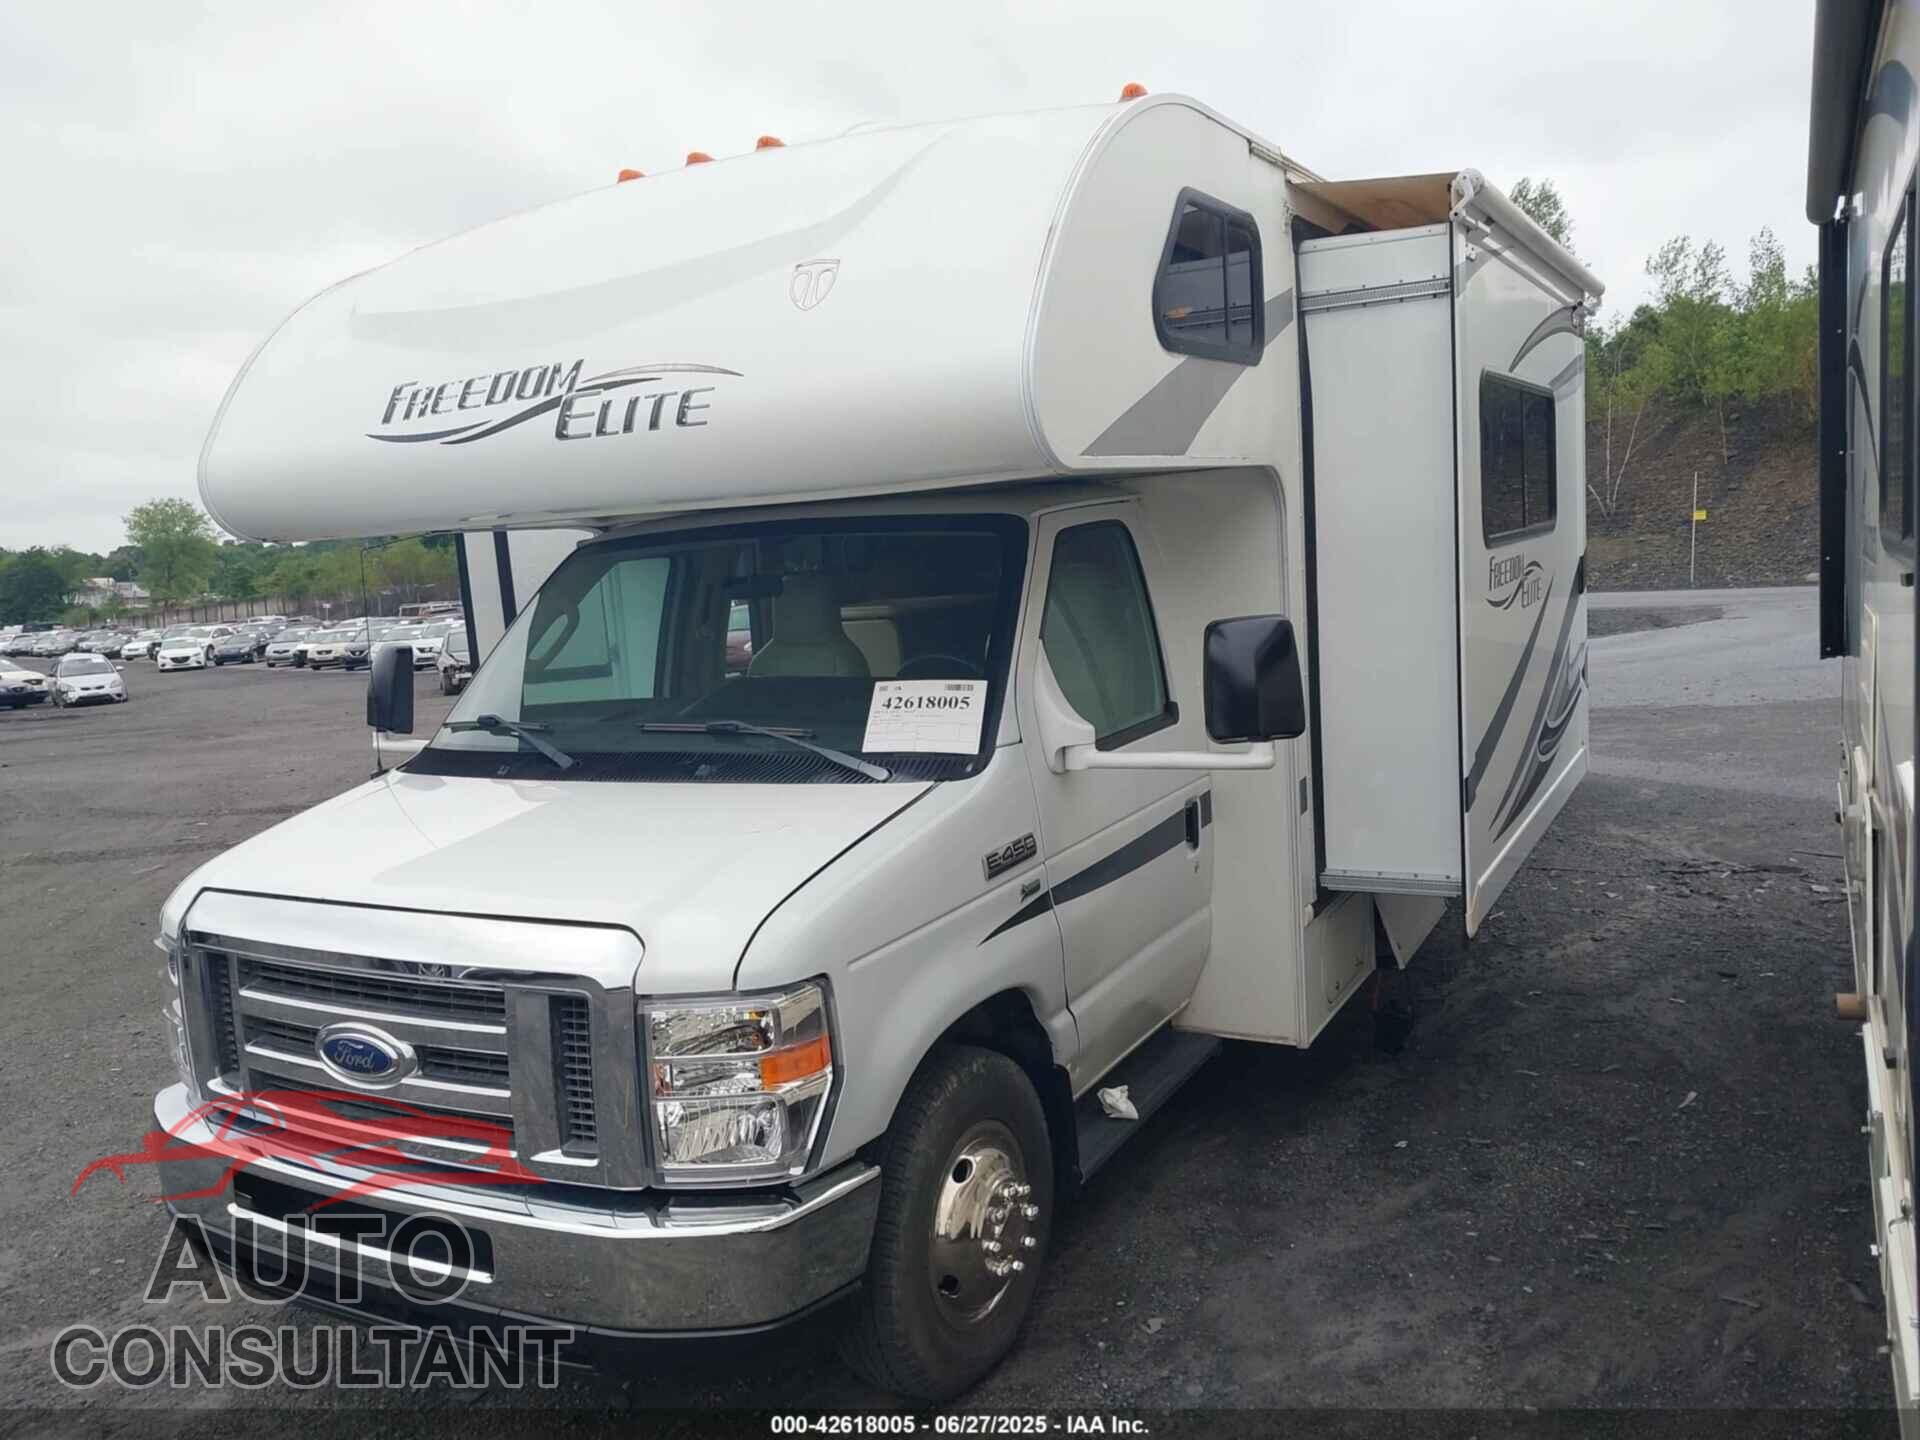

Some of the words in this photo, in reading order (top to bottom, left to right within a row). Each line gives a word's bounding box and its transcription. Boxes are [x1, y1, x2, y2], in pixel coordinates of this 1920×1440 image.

[380, 358, 584, 425] FREEDOM
[555, 387, 715, 441] ELITE
[1488, 551, 1525, 592] FREEDOM
[1521, 577, 1542, 608] ELITE
[882, 695, 971, 710] 42618005
[334, 1040, 376, 1070] Ford
